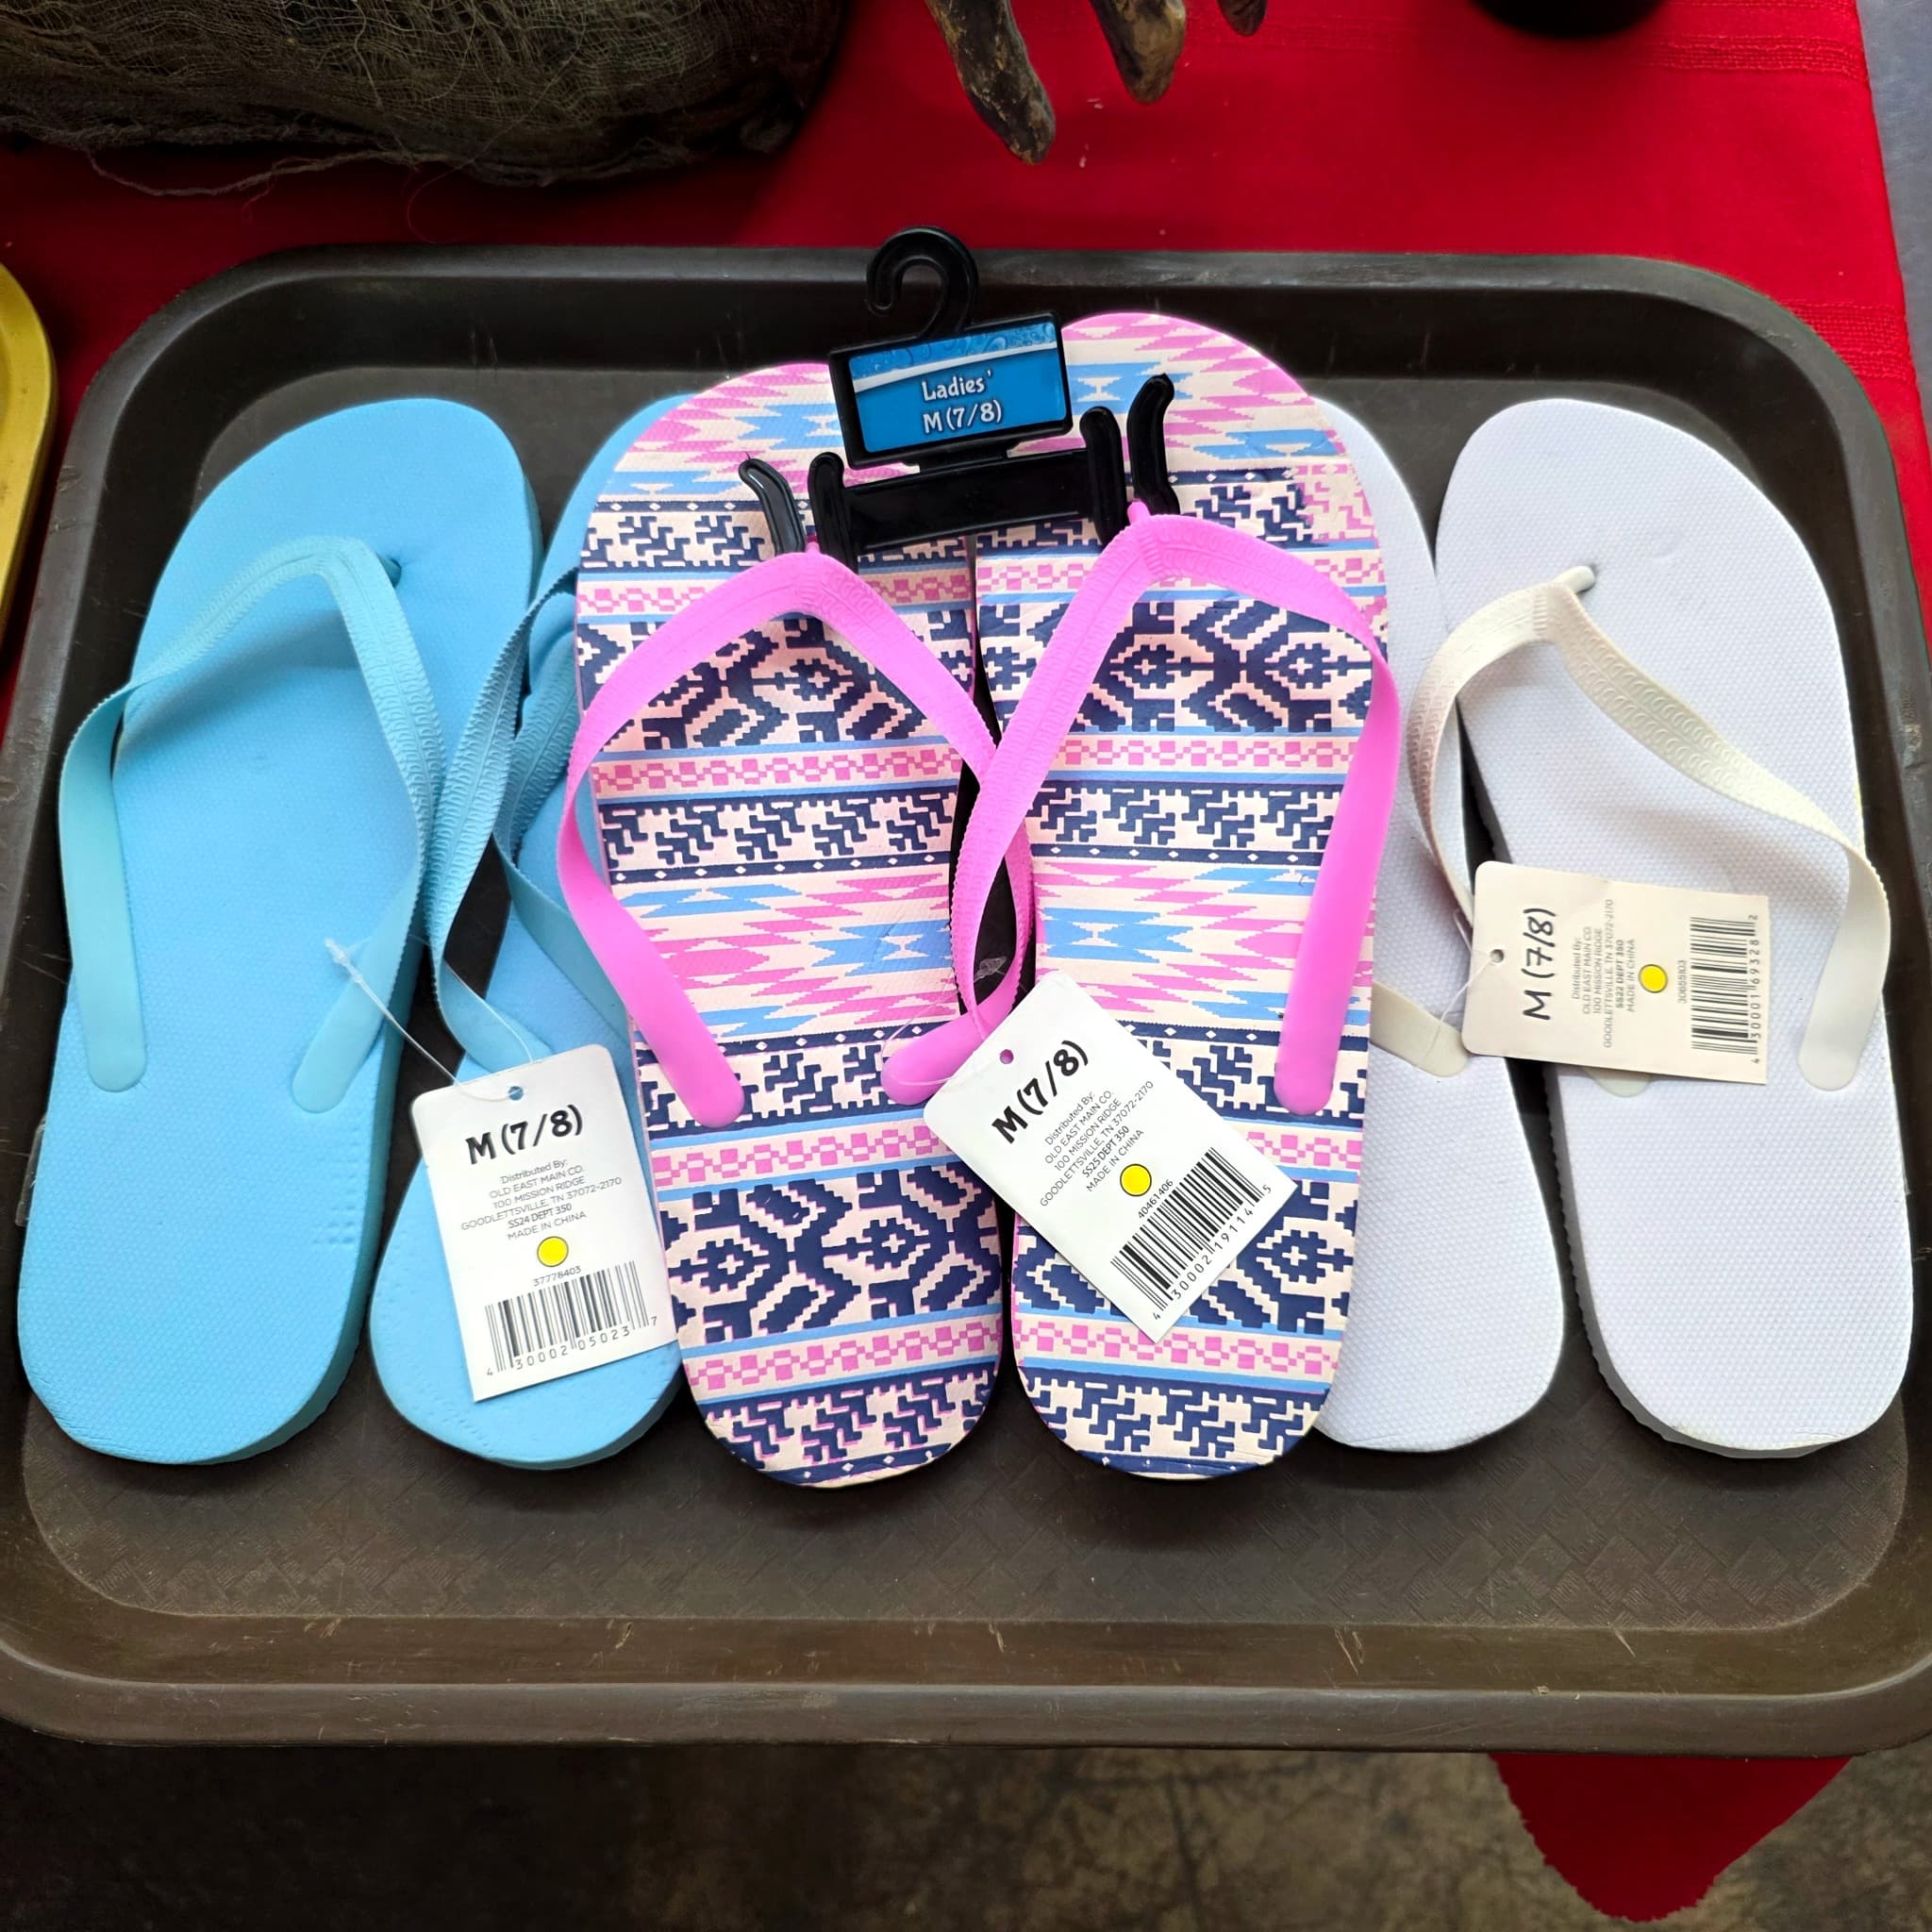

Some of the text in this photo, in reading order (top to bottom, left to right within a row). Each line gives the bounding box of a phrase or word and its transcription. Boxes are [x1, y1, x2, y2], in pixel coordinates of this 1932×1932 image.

[922, 369, 991, 401] Ladies'
[1521, 908, 1557, 1021] M (7/8)
[1044, 1091, 1095, 1145] Distributed By:
[1044, 1090, 1114, 1164] OLD EAST MAIN CO.
[1054, 1098, 1122, 1172] 100 MISSION RIDGE
[1040, 1080, 1154, 1207] GOODLETTSVILLE, TN 37072-2170
[1082, 1125, 1129, 1178] SS25 DEPT 350
[1086, 1129, 1144, 1192] MADE IN CHINA
[489, 1187, 511, 1199] OLD
[512, 1177, 538, 1192] EAST
[540, 1170, 566, 1184] MAIN
[499, 1161, 552, 1184] Distributed
[551, 1194, 564, 1203] TN
[565, 1176, 622, 1199] 37072-2170
[492, 1175, 586, 1208] 100 MISSION RIDGE
[1138, 1179, 1174, 1219] 40461406
[507, 1210, 587, 1240] MADE IN CHINA
[508, 1203, 572, 1229] SS24 DEPT 350
[533, 1265, 581, 1287] 37778403
